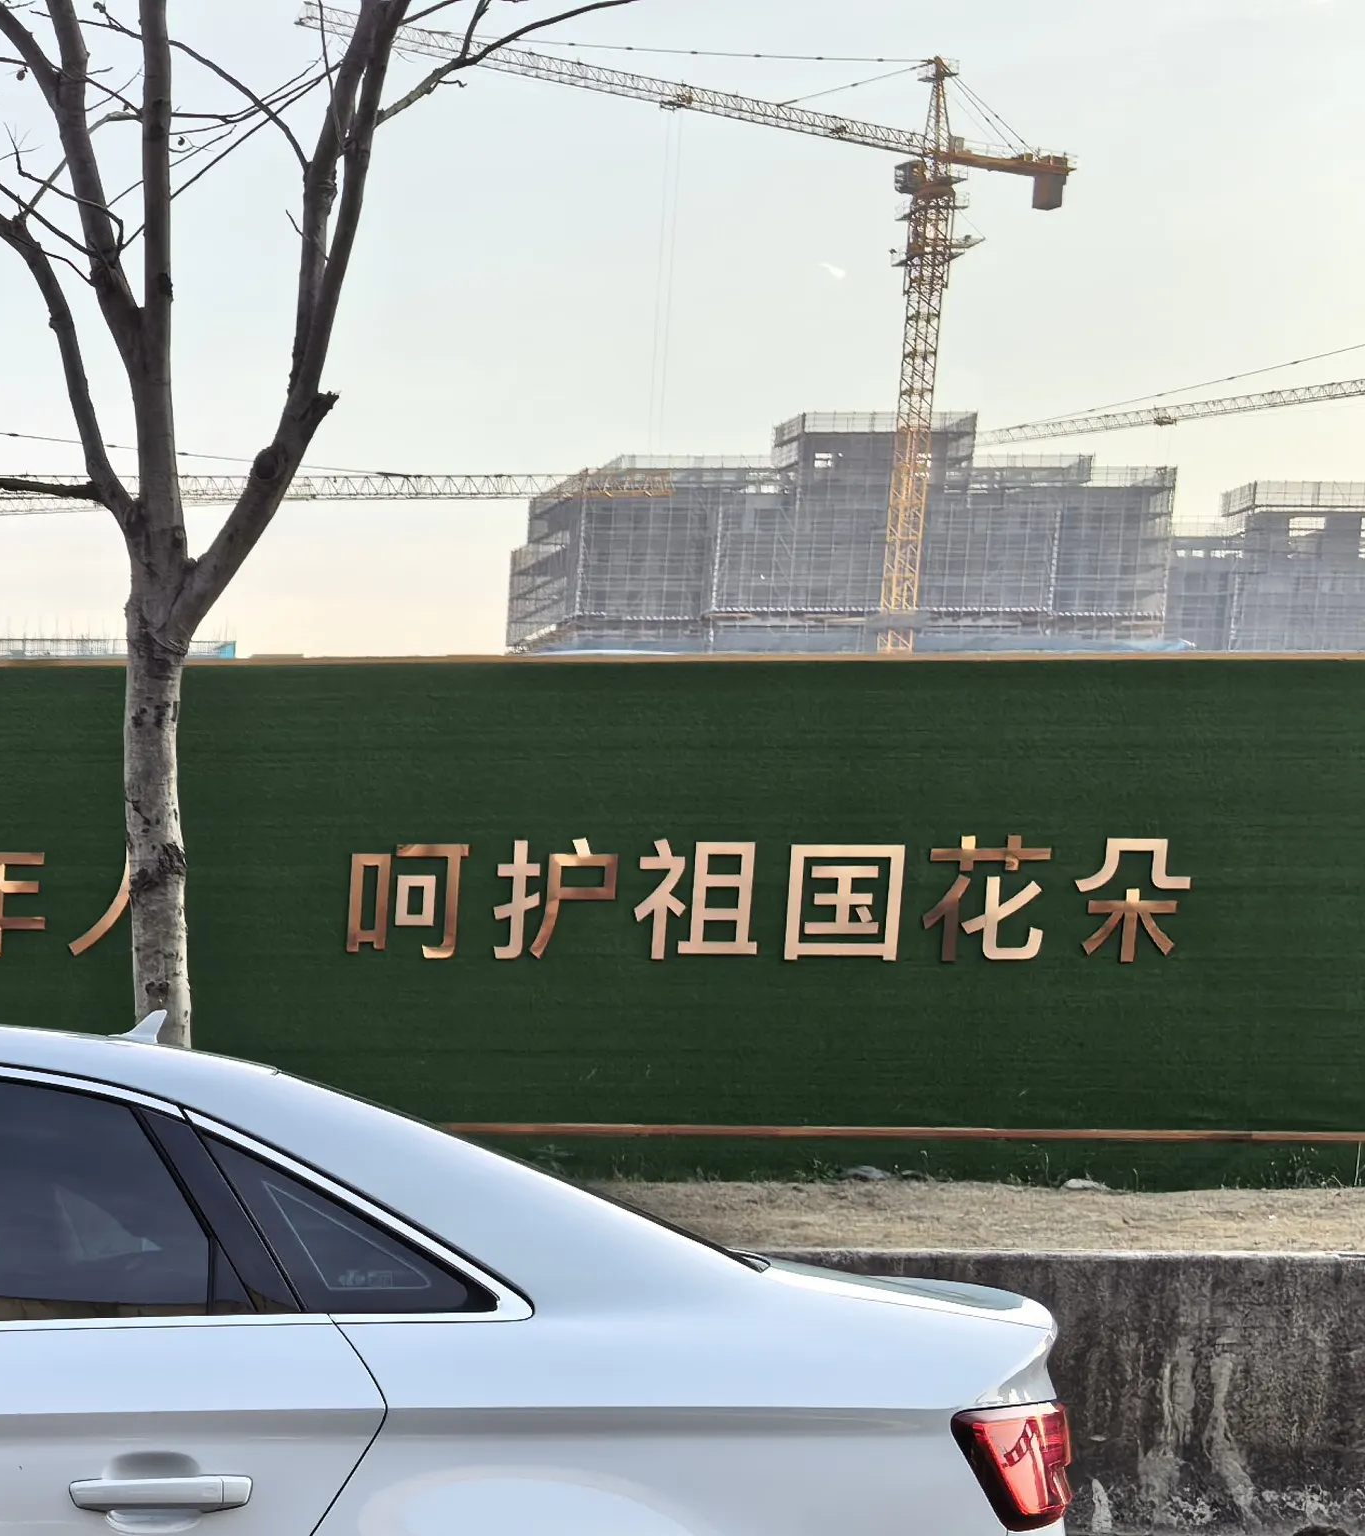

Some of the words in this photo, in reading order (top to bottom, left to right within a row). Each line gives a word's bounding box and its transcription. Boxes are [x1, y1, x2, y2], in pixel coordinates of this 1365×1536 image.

[345, 836, 1192, 963] 呵护祖国花朵
